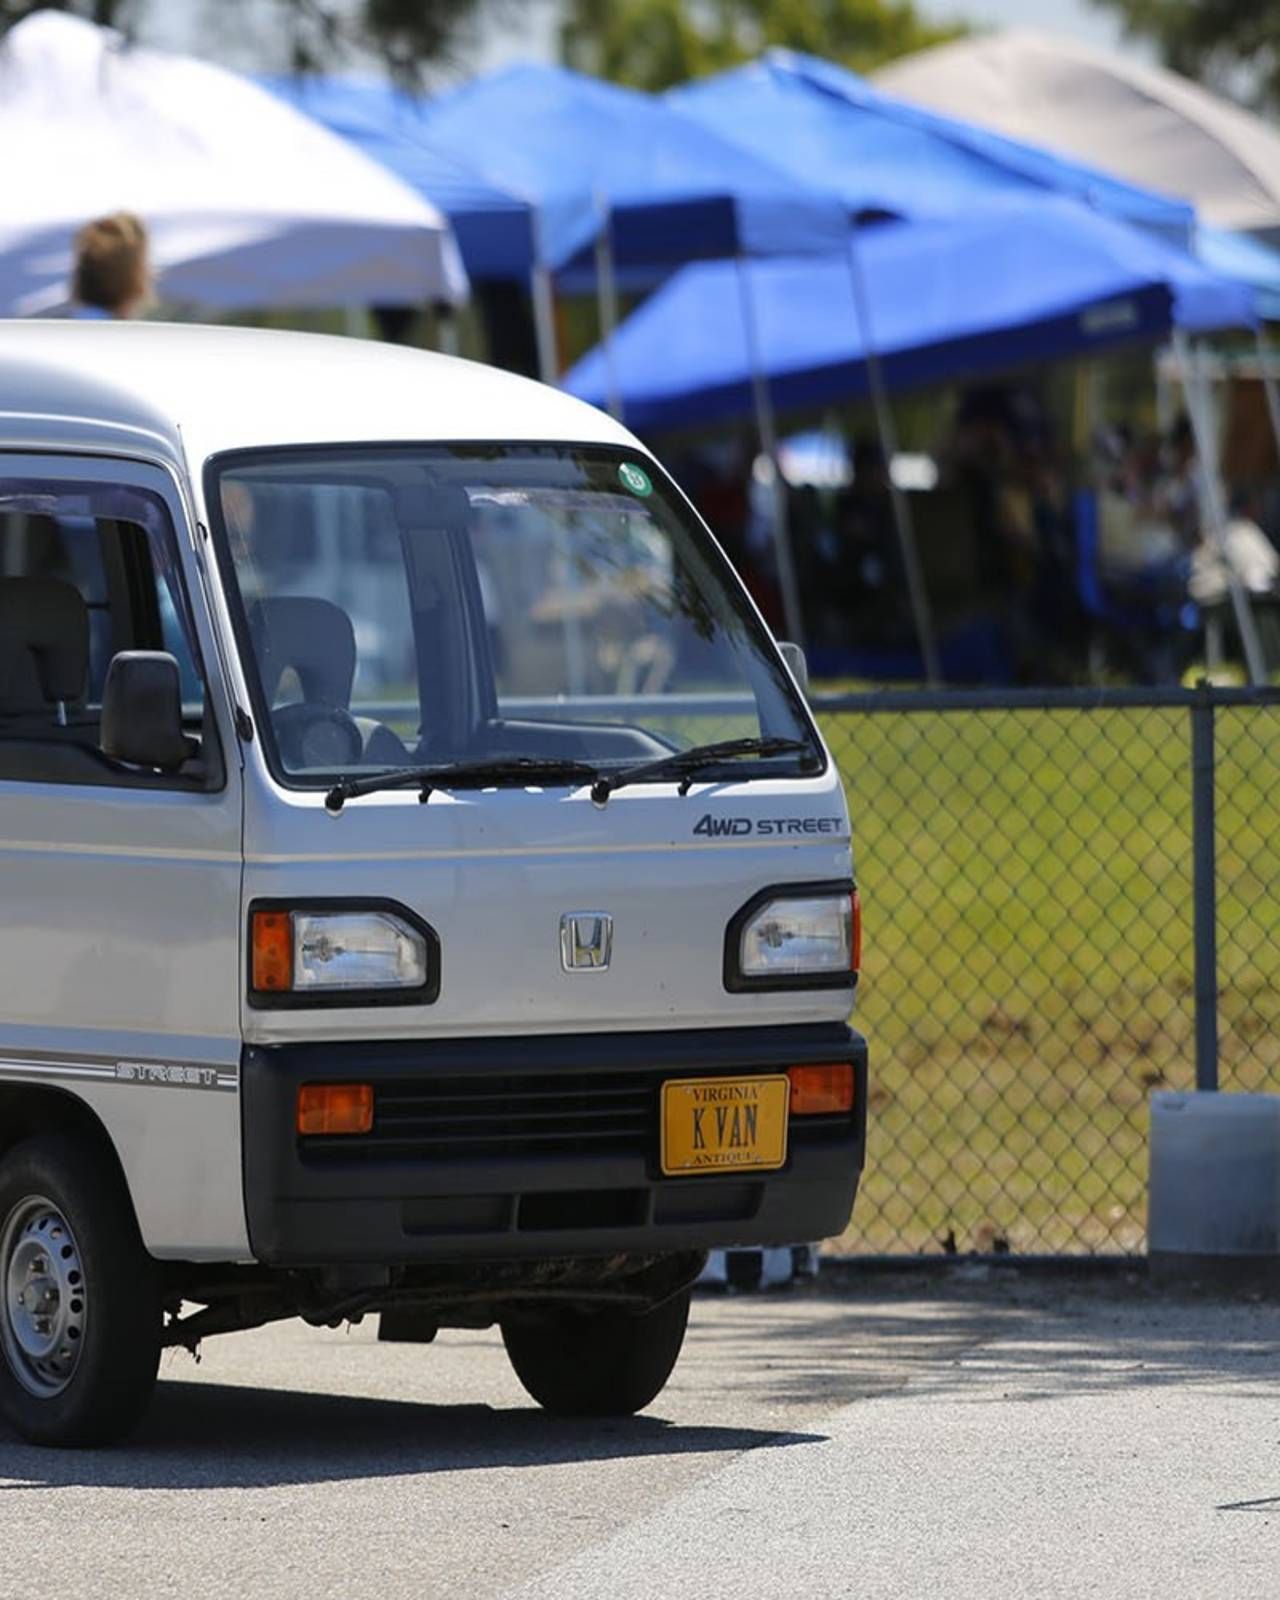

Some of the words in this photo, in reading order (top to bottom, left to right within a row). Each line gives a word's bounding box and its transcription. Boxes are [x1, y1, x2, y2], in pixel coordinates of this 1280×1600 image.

[693, 814, 752, 837] 4WD
[757, 818, 842, 835] STREET
[116, 1062, 216, 1085] STREET
[693, 1087, 758, 1102] VIRGINIA
[693, 1107, 705, 1149] K
[715, 1104, 758, 1148] VAN
